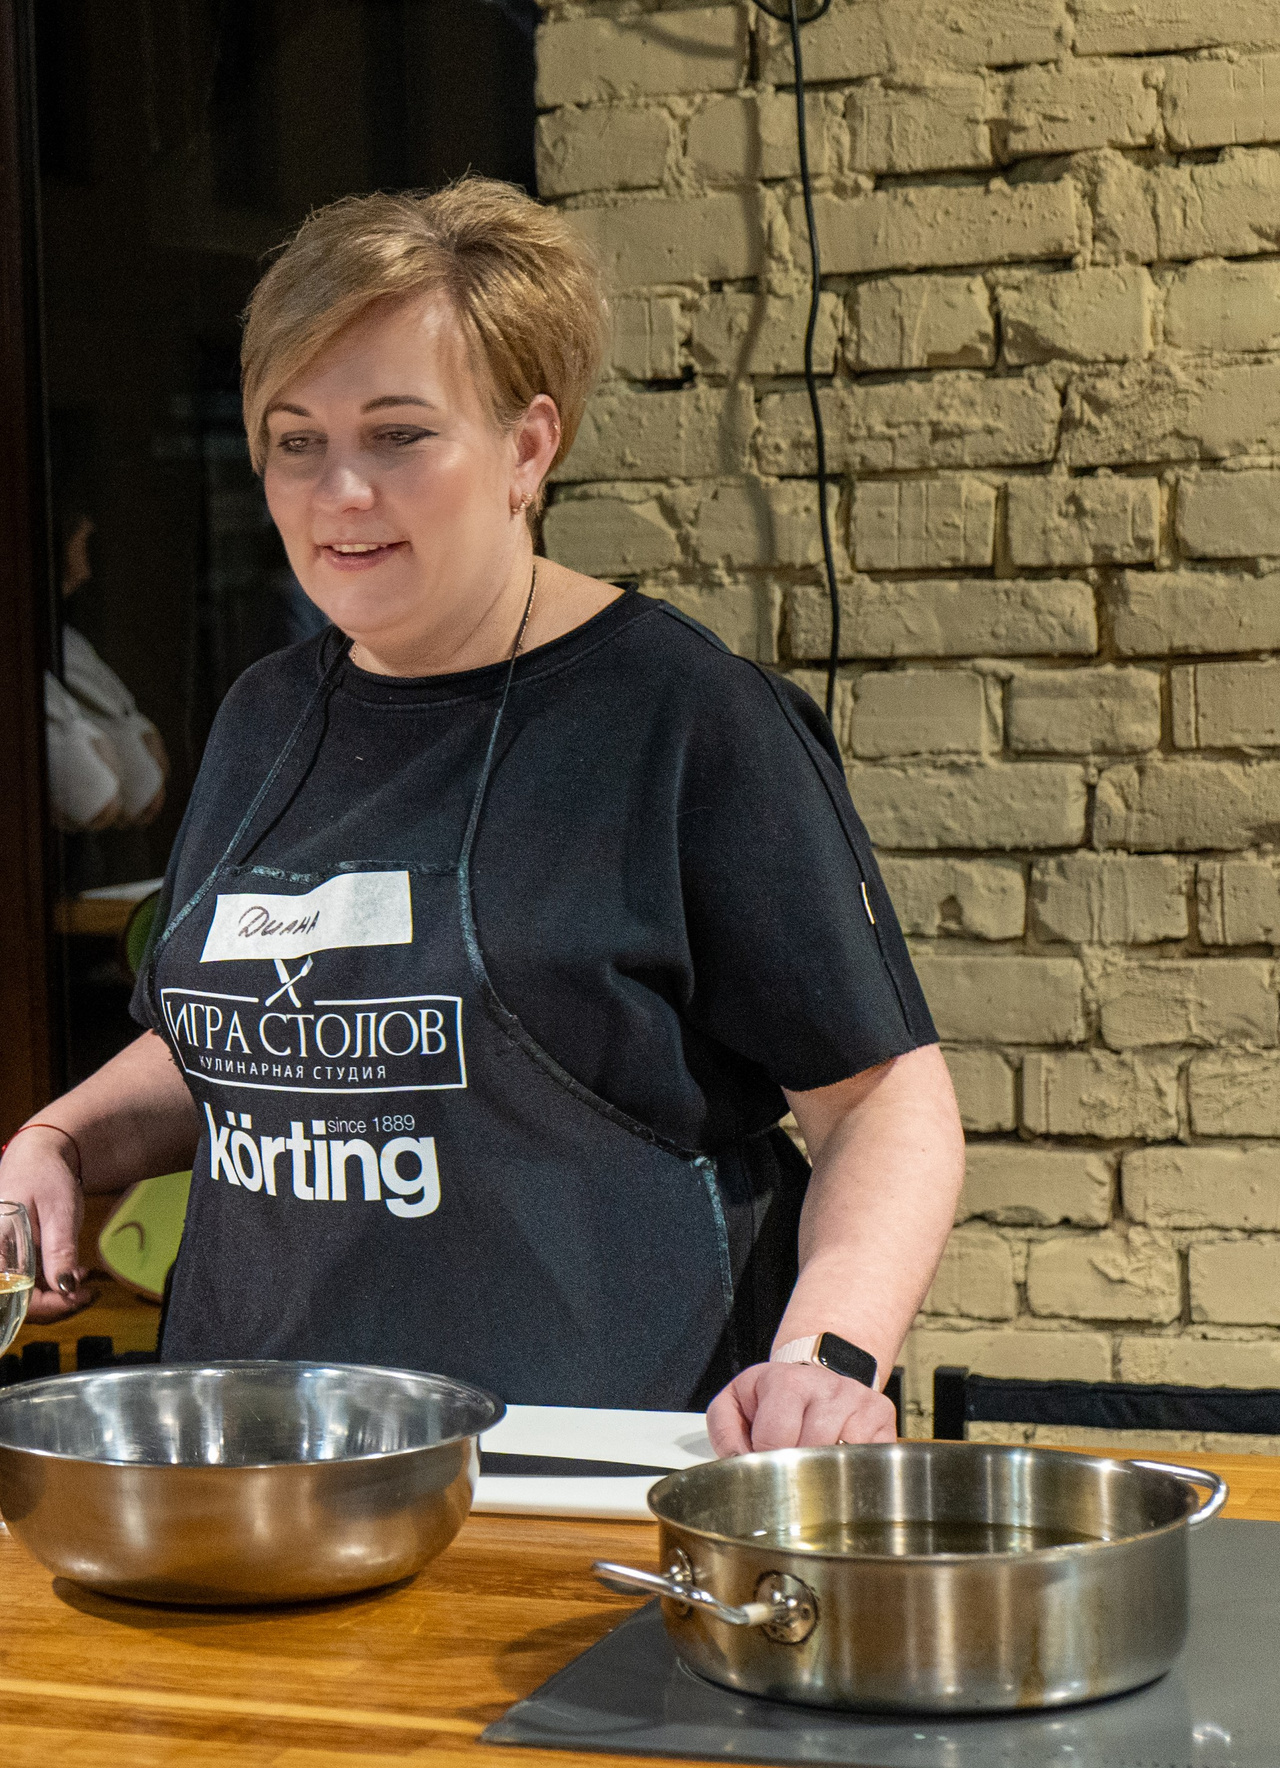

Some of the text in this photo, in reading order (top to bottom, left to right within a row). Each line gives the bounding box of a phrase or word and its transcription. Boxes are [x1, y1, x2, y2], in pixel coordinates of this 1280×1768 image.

[166, 1000, 447, 1059] ИГРА СТОЛОВ
[199, 1054, 387, 1082] КУЛИНАРНАЯ СТУДИЯ
[327, 1114, 416, 1134] since 1889
[204, 1101, 442, 1218] körting
